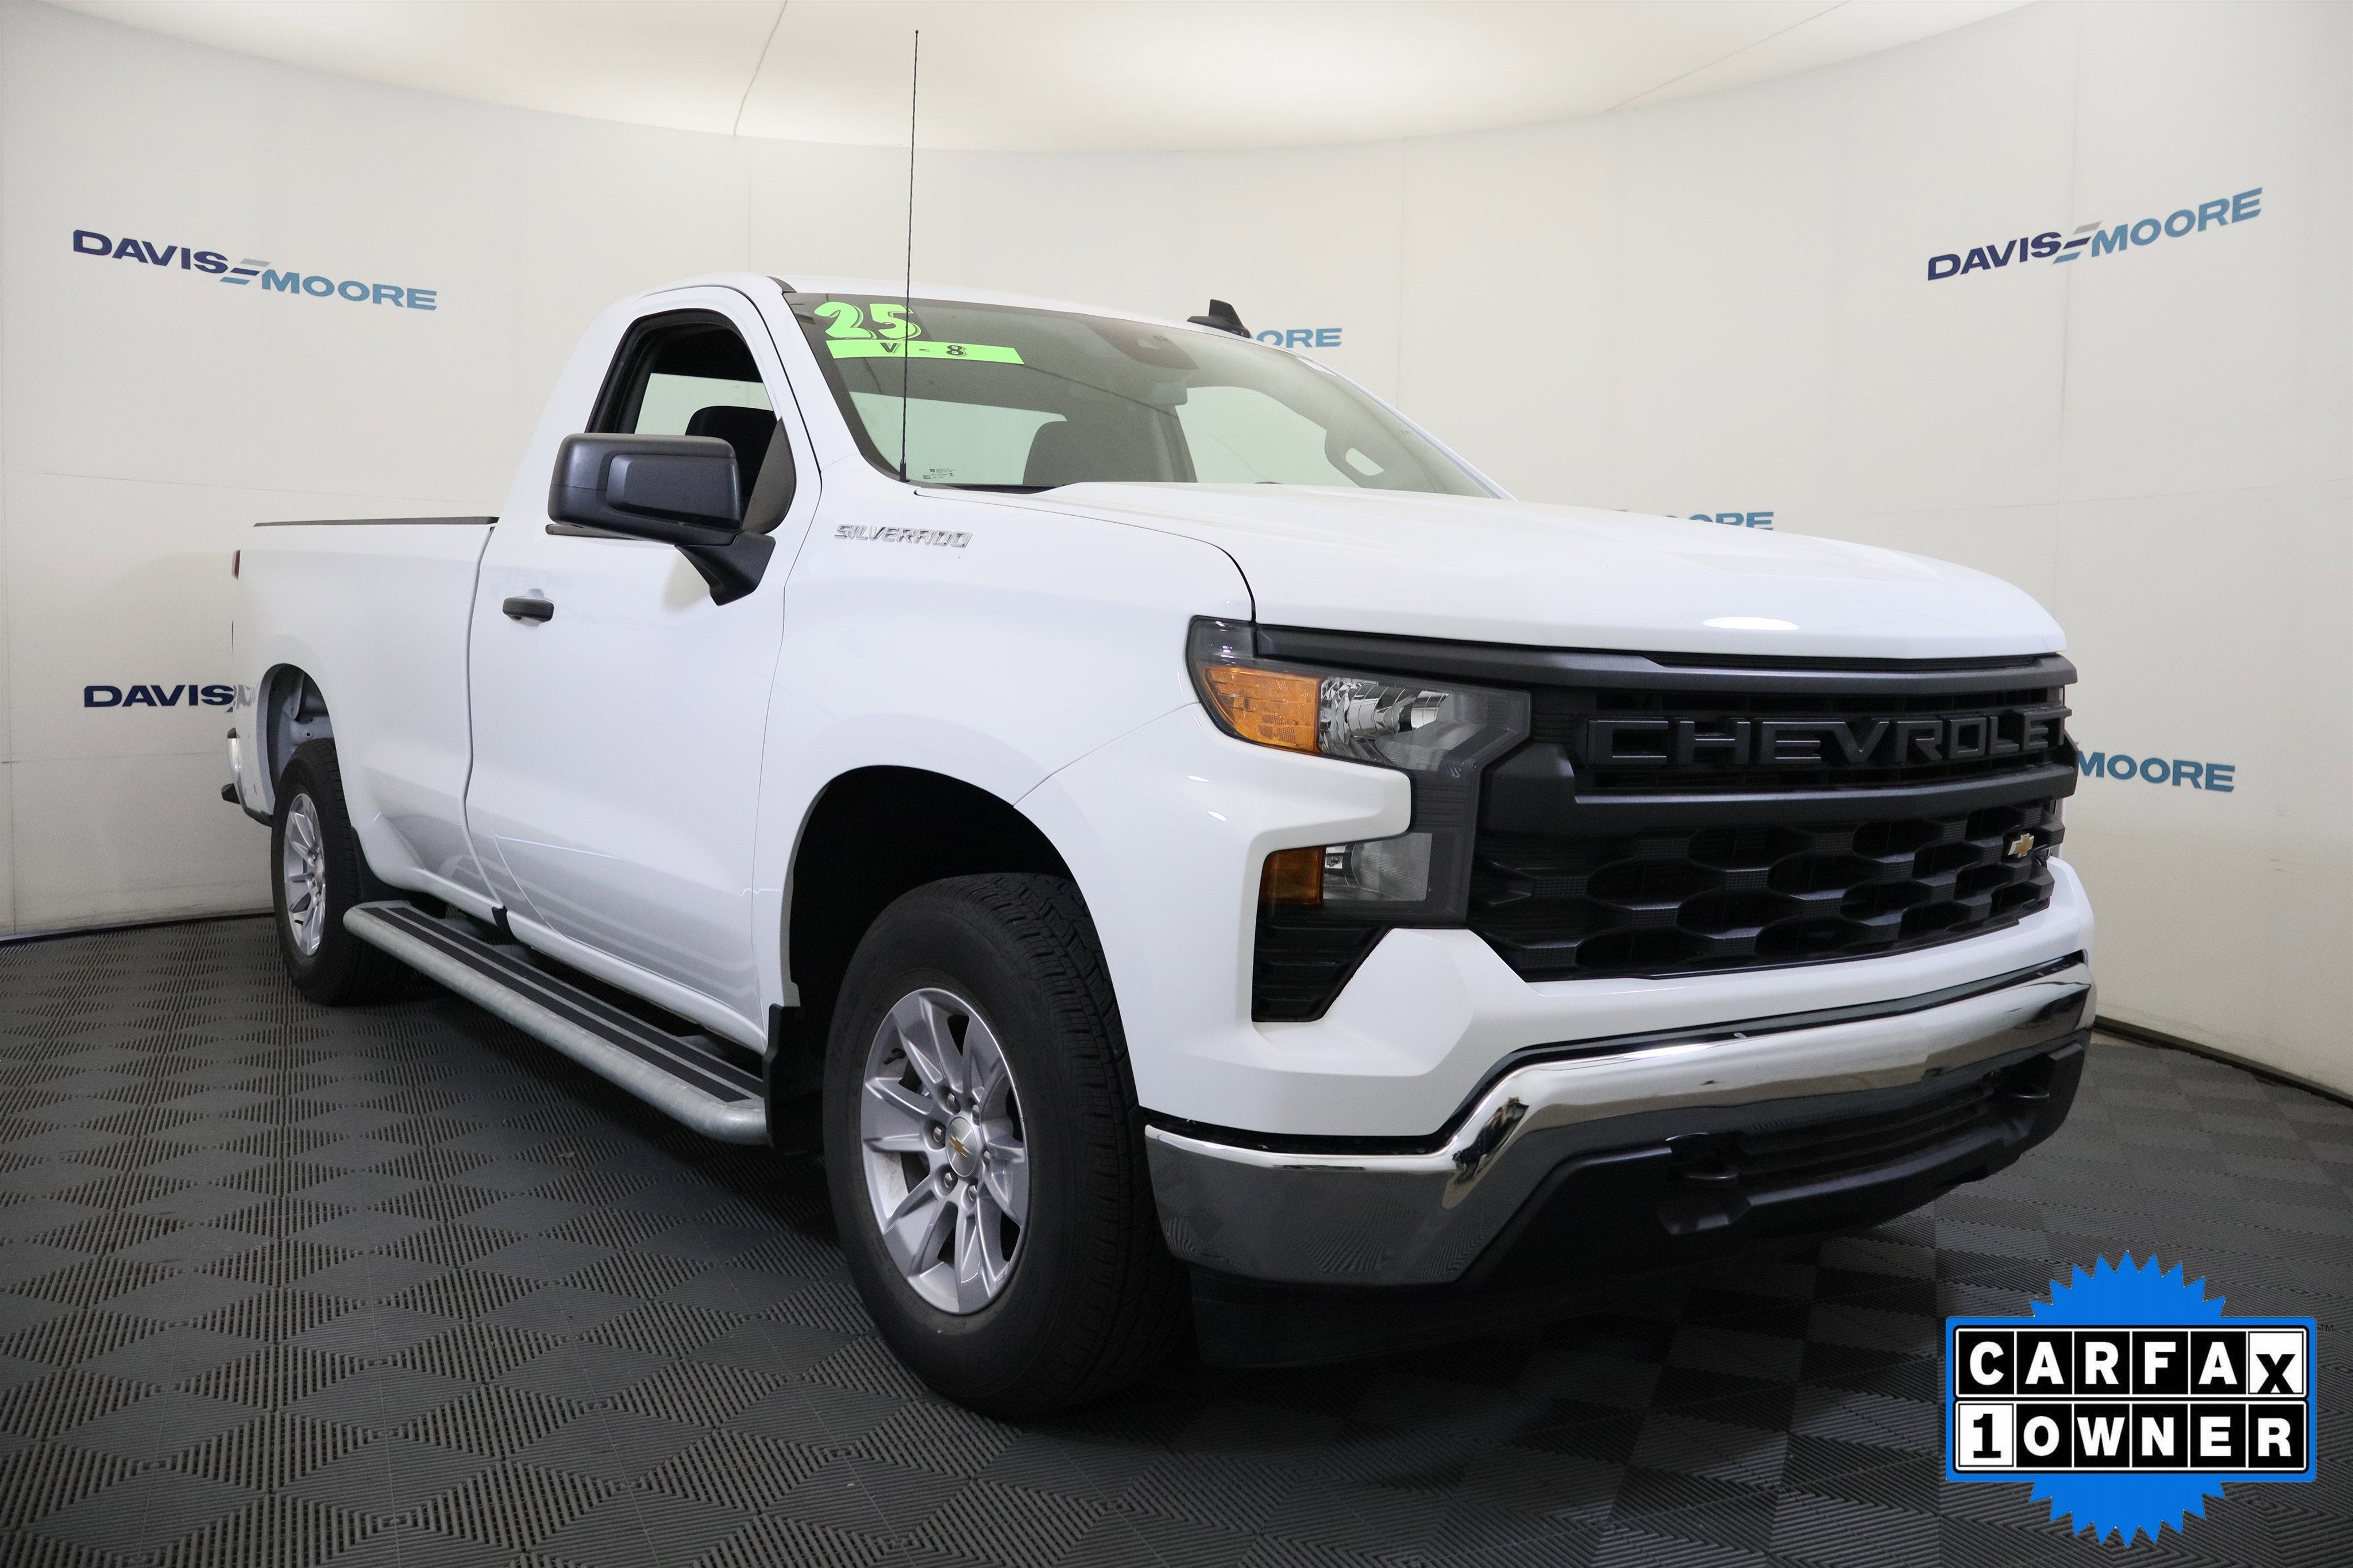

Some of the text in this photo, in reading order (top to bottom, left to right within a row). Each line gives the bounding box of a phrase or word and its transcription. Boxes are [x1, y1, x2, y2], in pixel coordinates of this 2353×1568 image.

[1928, 187, 2262, 281] DAVIS MOORE
[72, 229, 437, 311] DAVIS MOORE
[813, 302, 921, 340] 25
[1251, 327, 1343, 349] ORE
[834, 523, 973, 548] SILVERADO
[84, 685, 234, 708] DAVIS
[2078, 751, 2235, 793] MOORE
